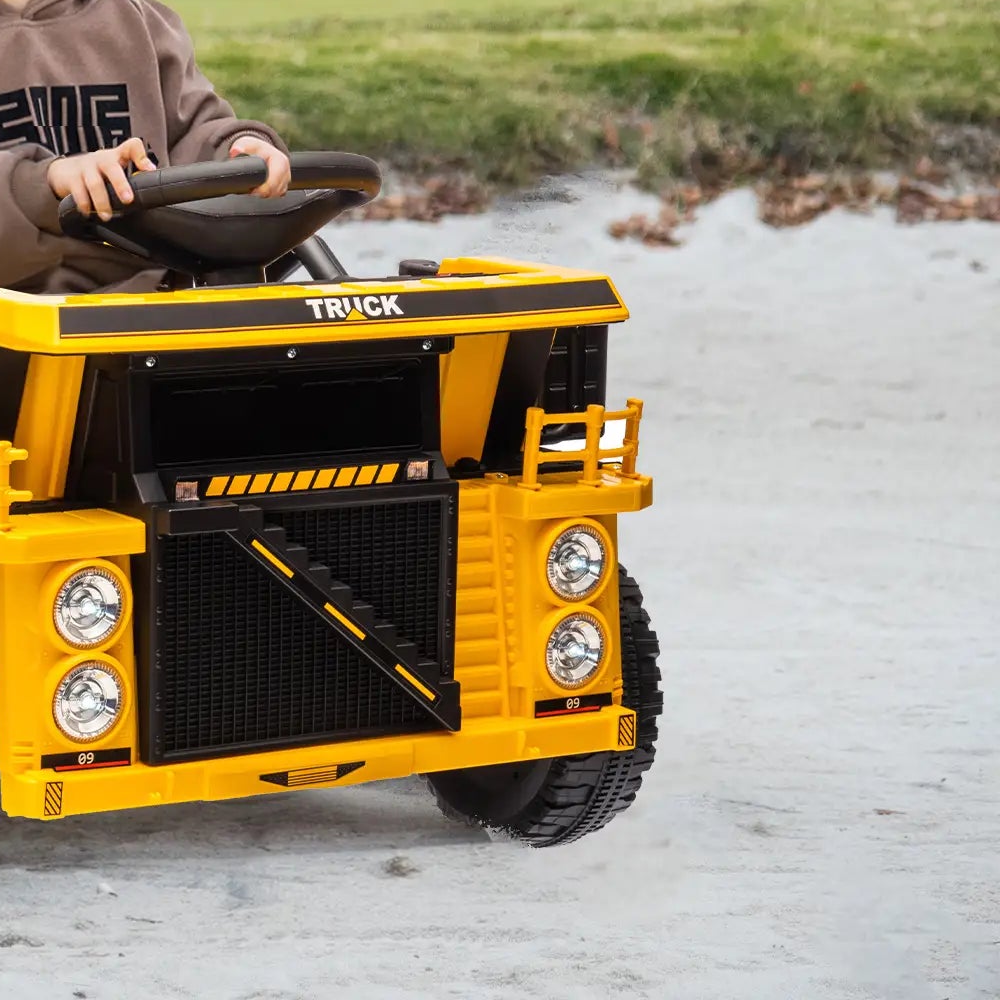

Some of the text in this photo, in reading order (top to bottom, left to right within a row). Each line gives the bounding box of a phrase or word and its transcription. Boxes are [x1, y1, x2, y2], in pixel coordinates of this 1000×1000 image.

[305, 294, 405, 320] TRUCK
[566, 697, 580, 709] 09
[78, 752, 94, 765] 09
